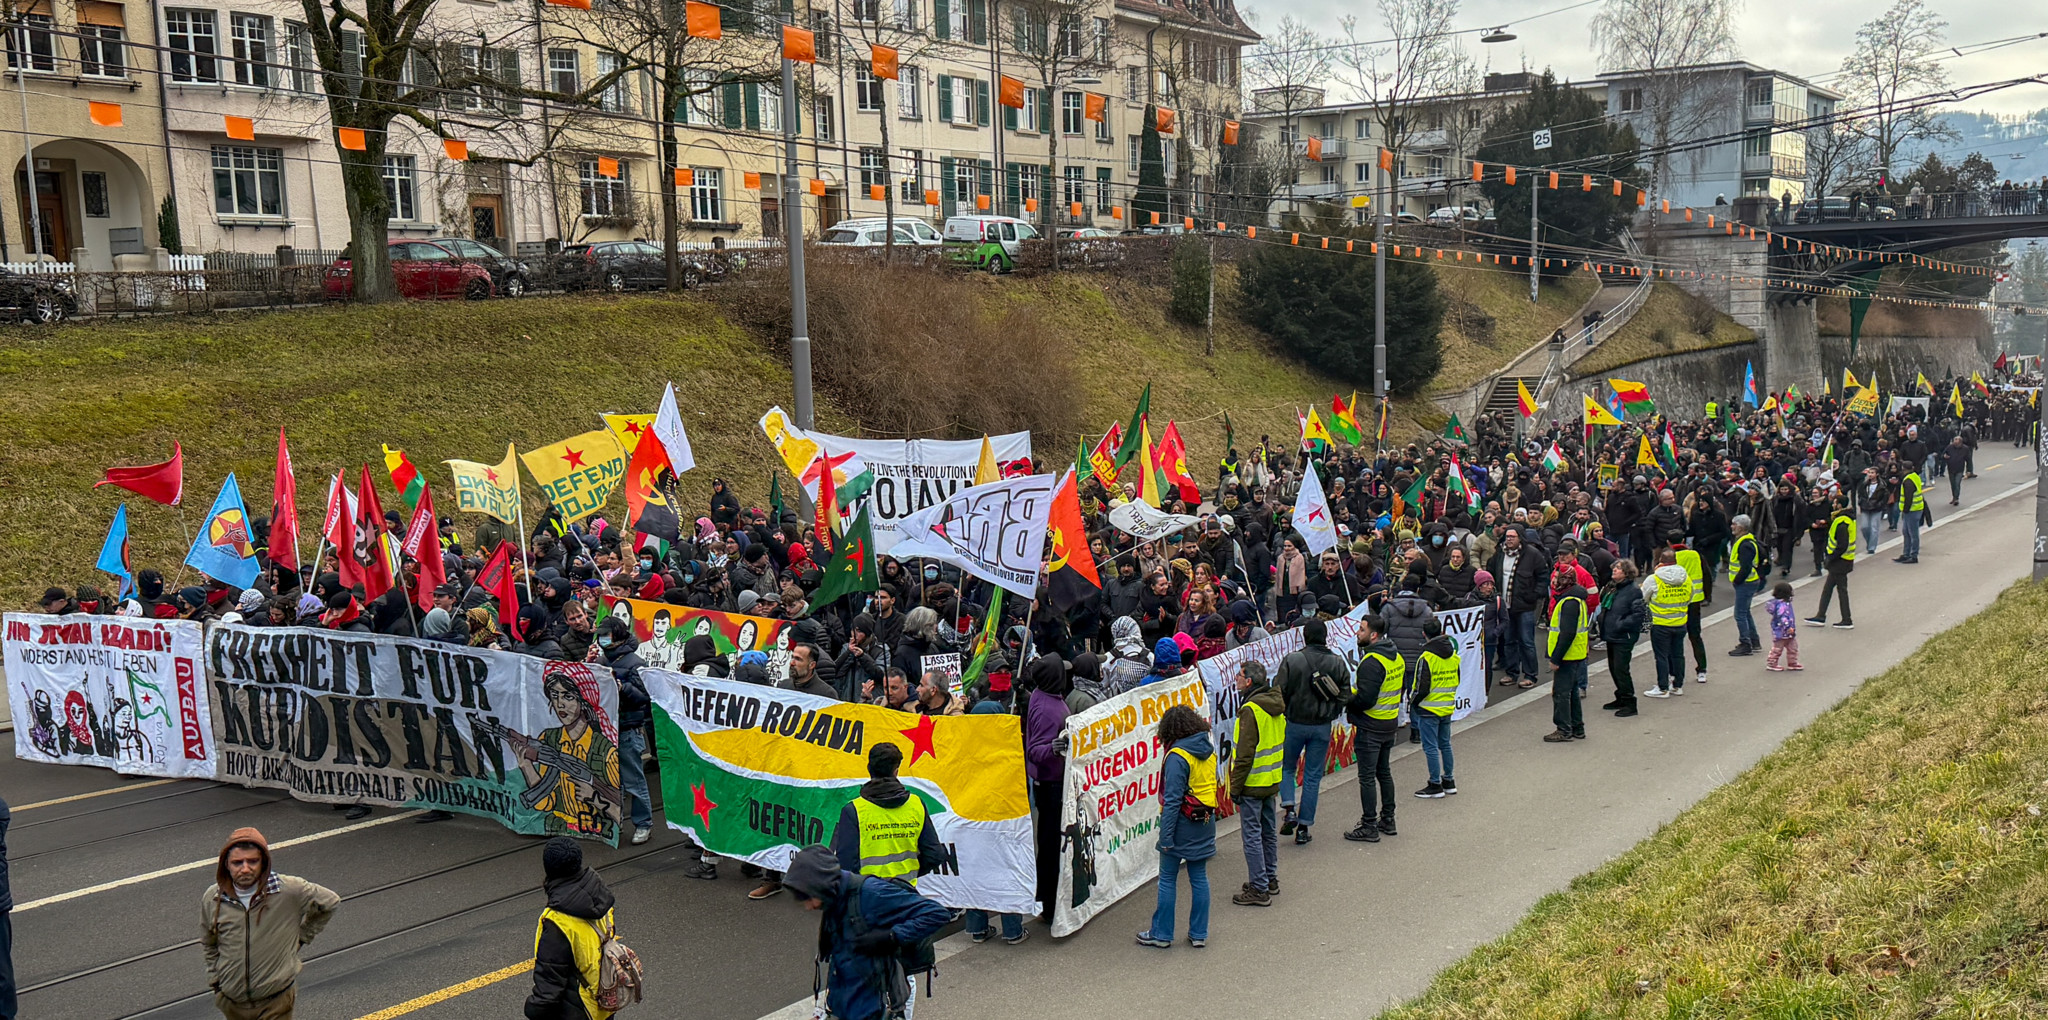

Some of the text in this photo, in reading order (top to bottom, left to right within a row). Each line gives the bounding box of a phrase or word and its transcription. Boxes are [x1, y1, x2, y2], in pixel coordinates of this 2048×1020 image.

[1535, 134, 1550, 146] 25
[542, 457, 623, 501] DEFEND
[877, 463, 894, 477] LIVE
[893, 465, 910, 478] THE
[912, 465, 967, 479] REVOLUTION
[408, 511, 431, 556] AUFBAU
[820, 526, 832, 552] Front
[7, 621, 171, 653] JIN JIYAN AZADÎ!
[924, 653, 959, 666] LASS DIE
[20, 648, 86, 666] WIDERSTAND
[113, 650, 157, 674] LEBEN
[211, 627, 493, 711] FREIHEIT FÜR
[176, 660, 205, 760] AUFBAU
[680, 685, 864, 756] DEFEND ROJAVA
[155, 721, 169, 767] Rojava
[215, 681, 506, 785] KURDISTAN
[226, 751, 256, 780] HOCH
[413, 776, 518, 825] SOLIDARITÄT
[1082, 741, 1148, 792] JUGEND
[749, 798, 824, 846] DEFEND
[1122, 819, 1151, 845] JIYAN
